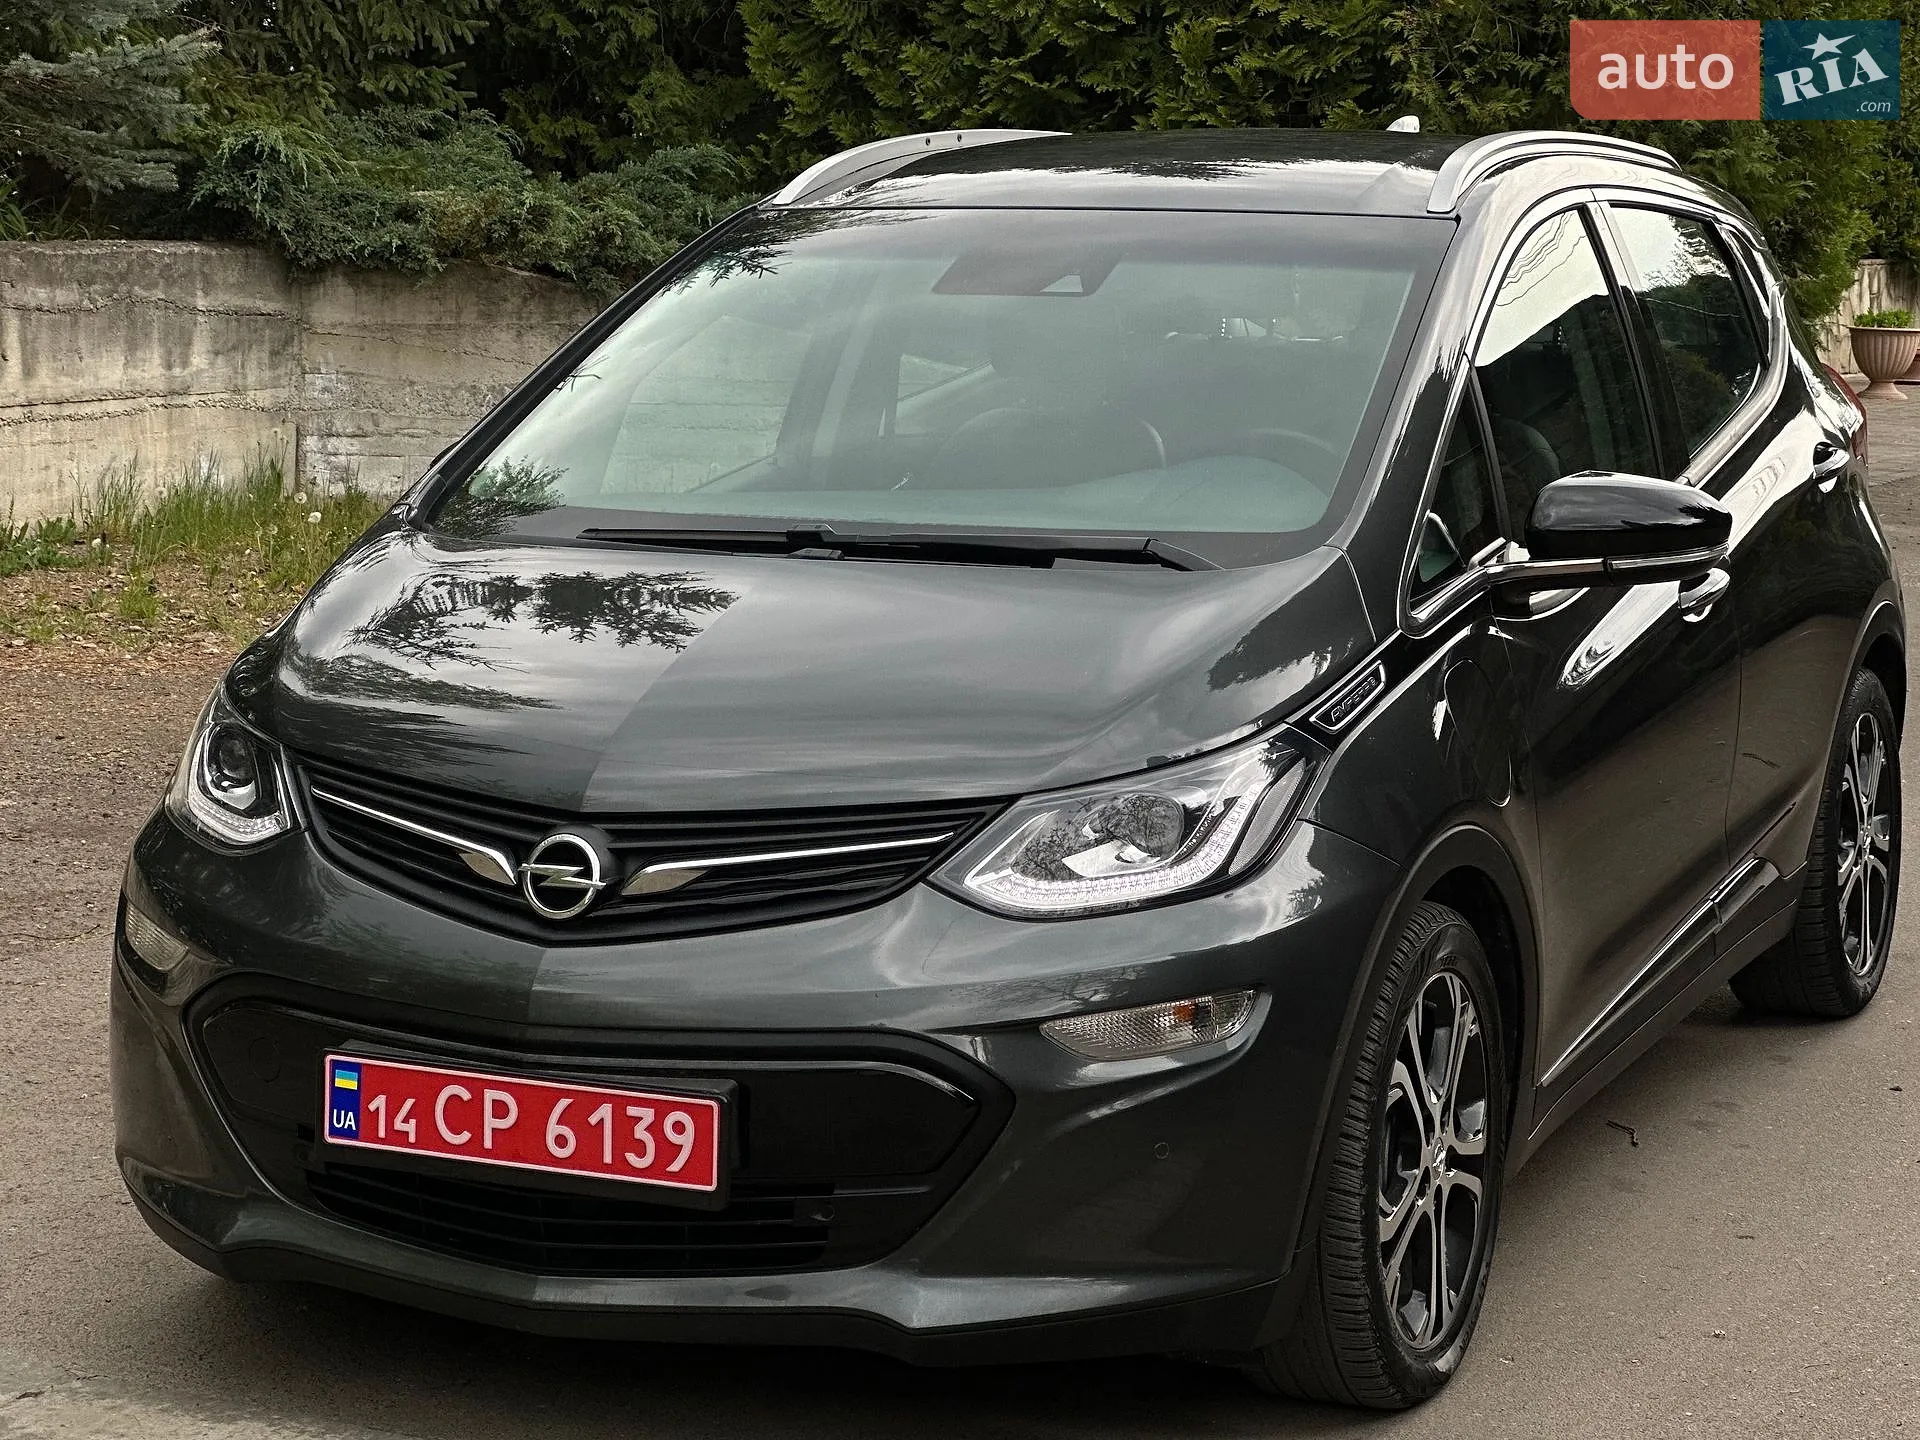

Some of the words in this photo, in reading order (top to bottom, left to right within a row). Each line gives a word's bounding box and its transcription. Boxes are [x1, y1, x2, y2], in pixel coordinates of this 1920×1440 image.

[332, 1108, 356, 1131] UA
[367, 1094, 417, 1144] 14
[434, 1084, 519, 1150] CP
[545, 1098, 695, 1173] 6139
